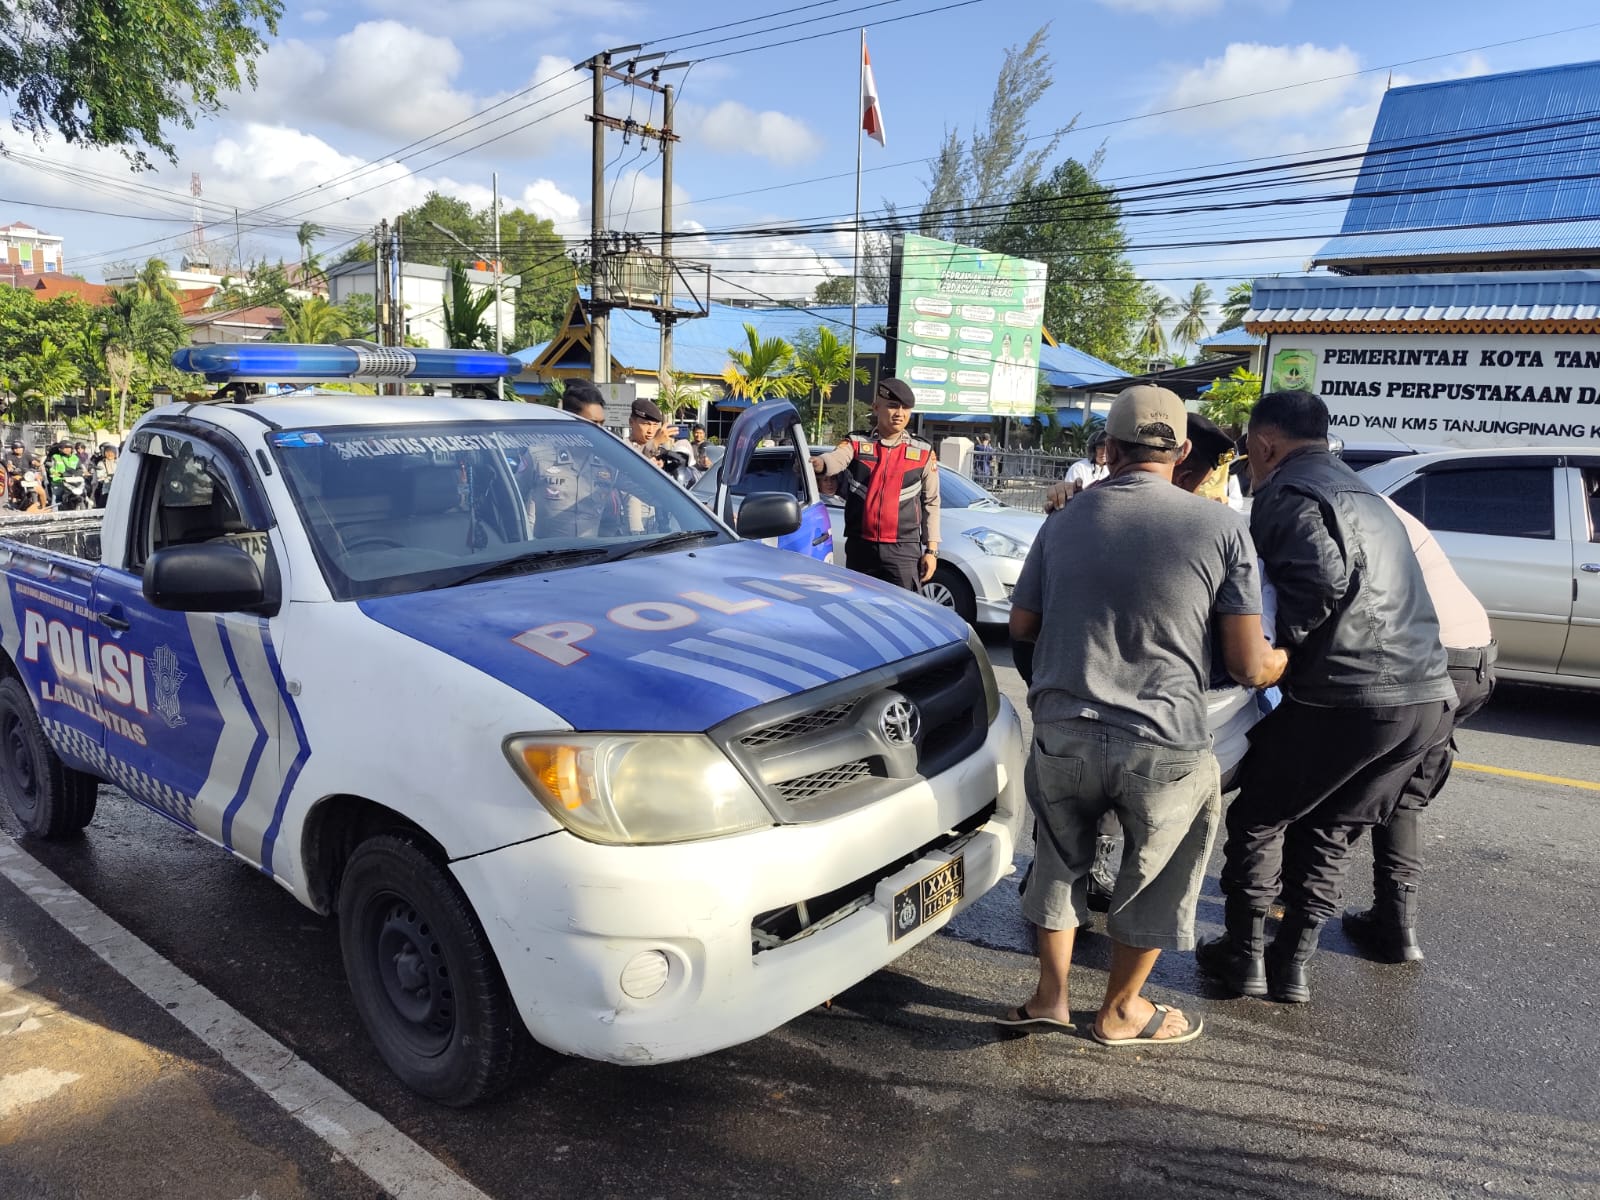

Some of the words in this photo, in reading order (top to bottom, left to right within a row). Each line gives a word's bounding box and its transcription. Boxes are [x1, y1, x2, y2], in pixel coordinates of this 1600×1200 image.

[1323, 349, 1469, 366] PEMERINTAH
[1479, 350, 1544, 367] KOTA
[1320, 380, 1382, 397] DINAS
[1386, 382, 1573, 404] PERPUSTAKAAN
[1363, 415, 1397, 429] YANI
[1442, 419, 1585, 438] TANJUNGPINANG
[24, 607, 150, 716] POLISI
[41, 680, 86, 713] LALU
[86, 698, 148, 747] LINTAS
[928, 863, 960, 896] XXXI
